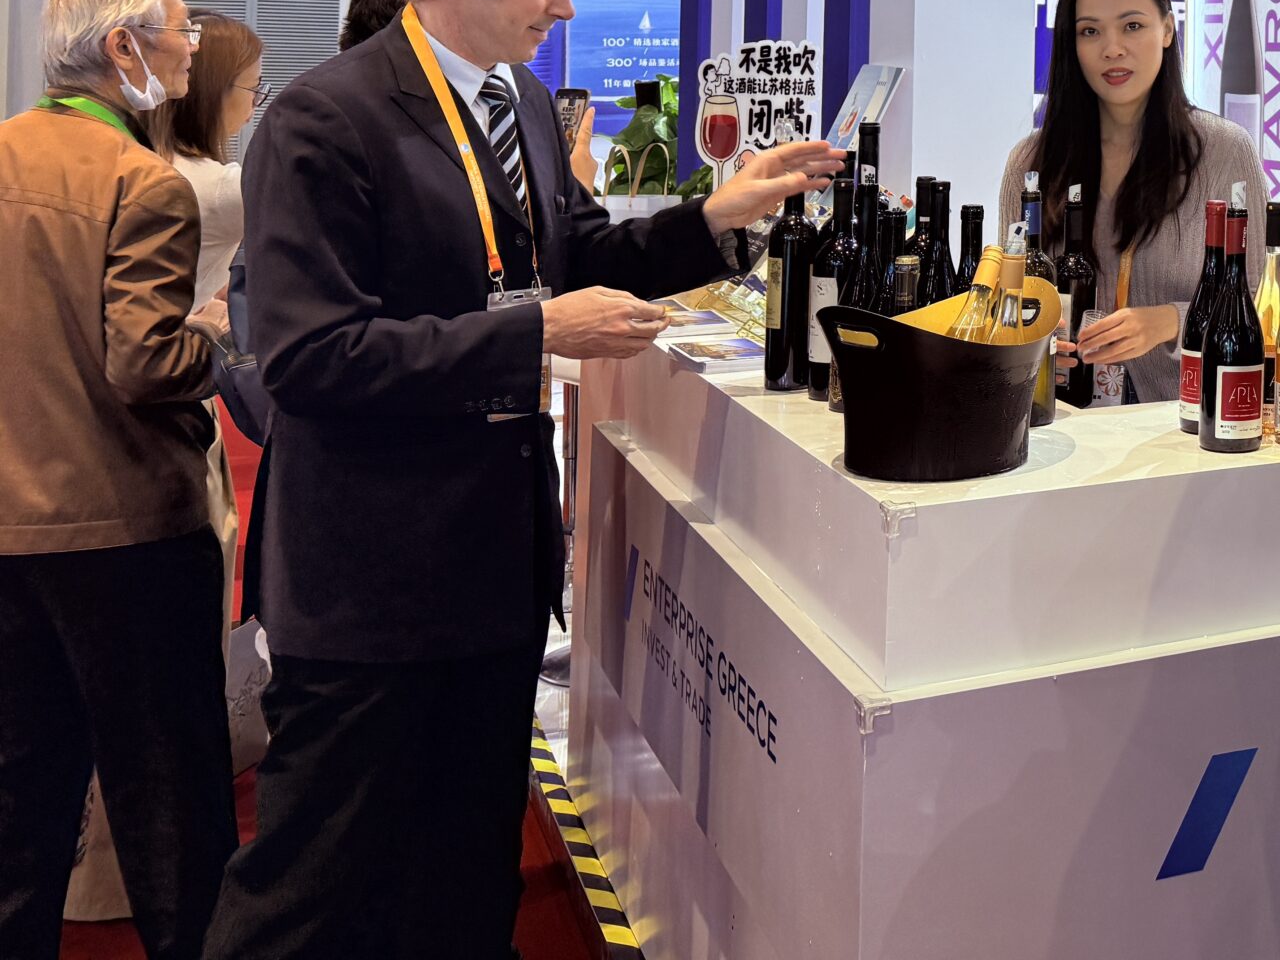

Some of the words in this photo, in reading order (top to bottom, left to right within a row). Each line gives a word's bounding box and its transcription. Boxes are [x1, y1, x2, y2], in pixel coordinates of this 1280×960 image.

[739, 44, 816, 76] 不是我吹
[723, 77, 816, 96] 这酒能让苏格拉底
[1182, 370, 1198, 387] APL
[1228, 385, 1258, 403] APLA
[643, 559, 714, 680] ENTERPRISE
[718, 651, 777, 764] GREECE
[641, 619, 671, 677] INVEST
[671, 660, 677, 688] &
[680, 669, 711, 738] TRADE
